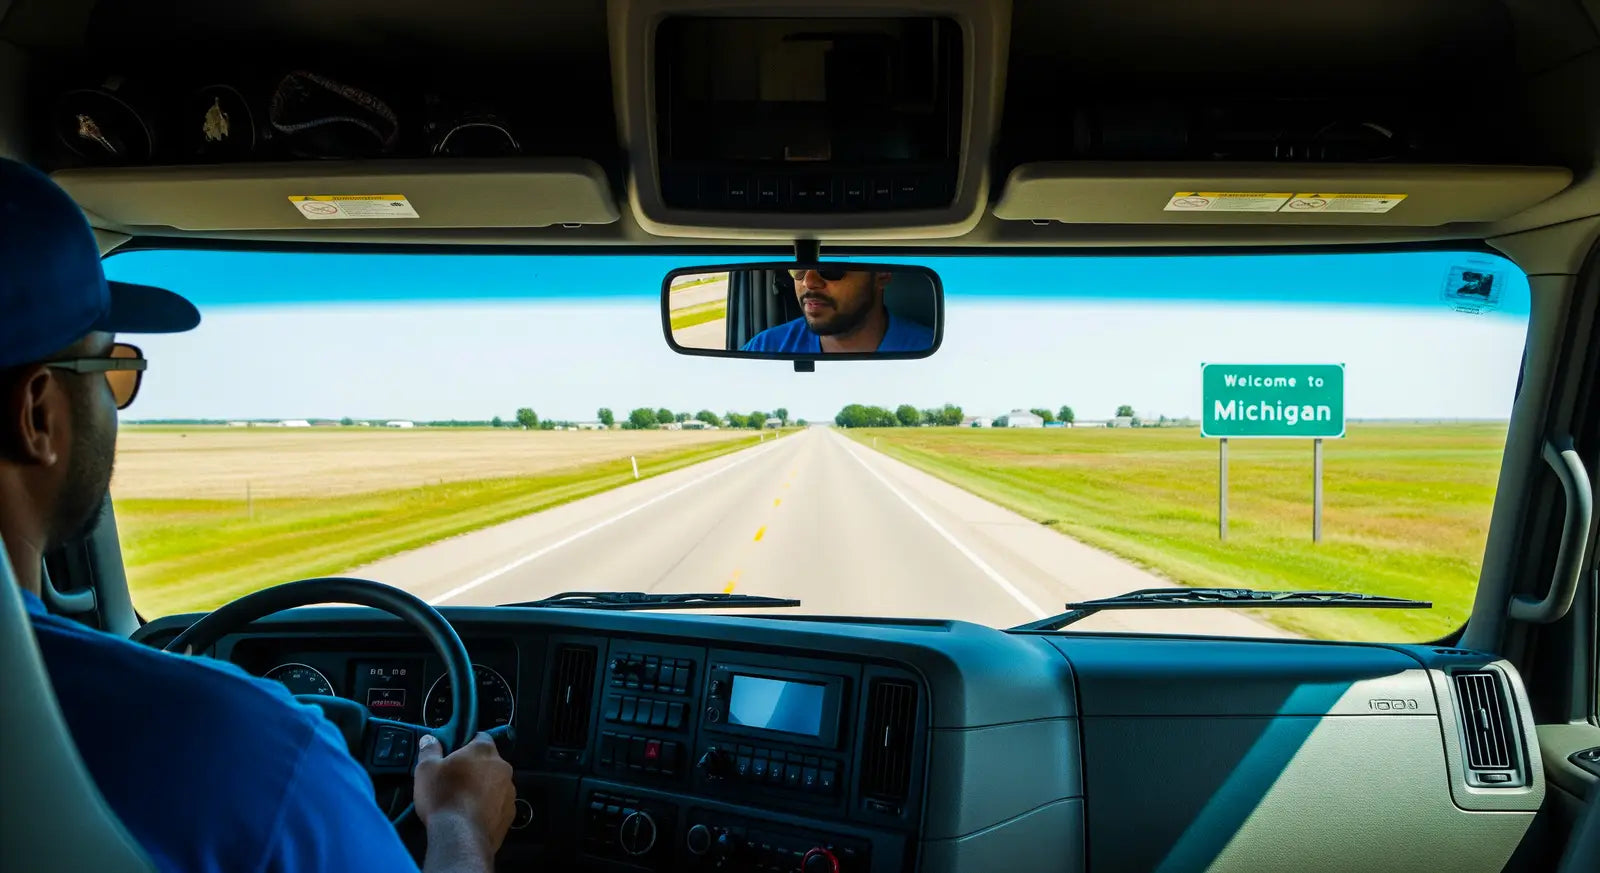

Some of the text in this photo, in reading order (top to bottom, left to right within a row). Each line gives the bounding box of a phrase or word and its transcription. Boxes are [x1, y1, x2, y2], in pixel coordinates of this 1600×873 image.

[1224, 374, 1324, 387] Welcome to
[1214, 399, 1331, 425] Michigan
